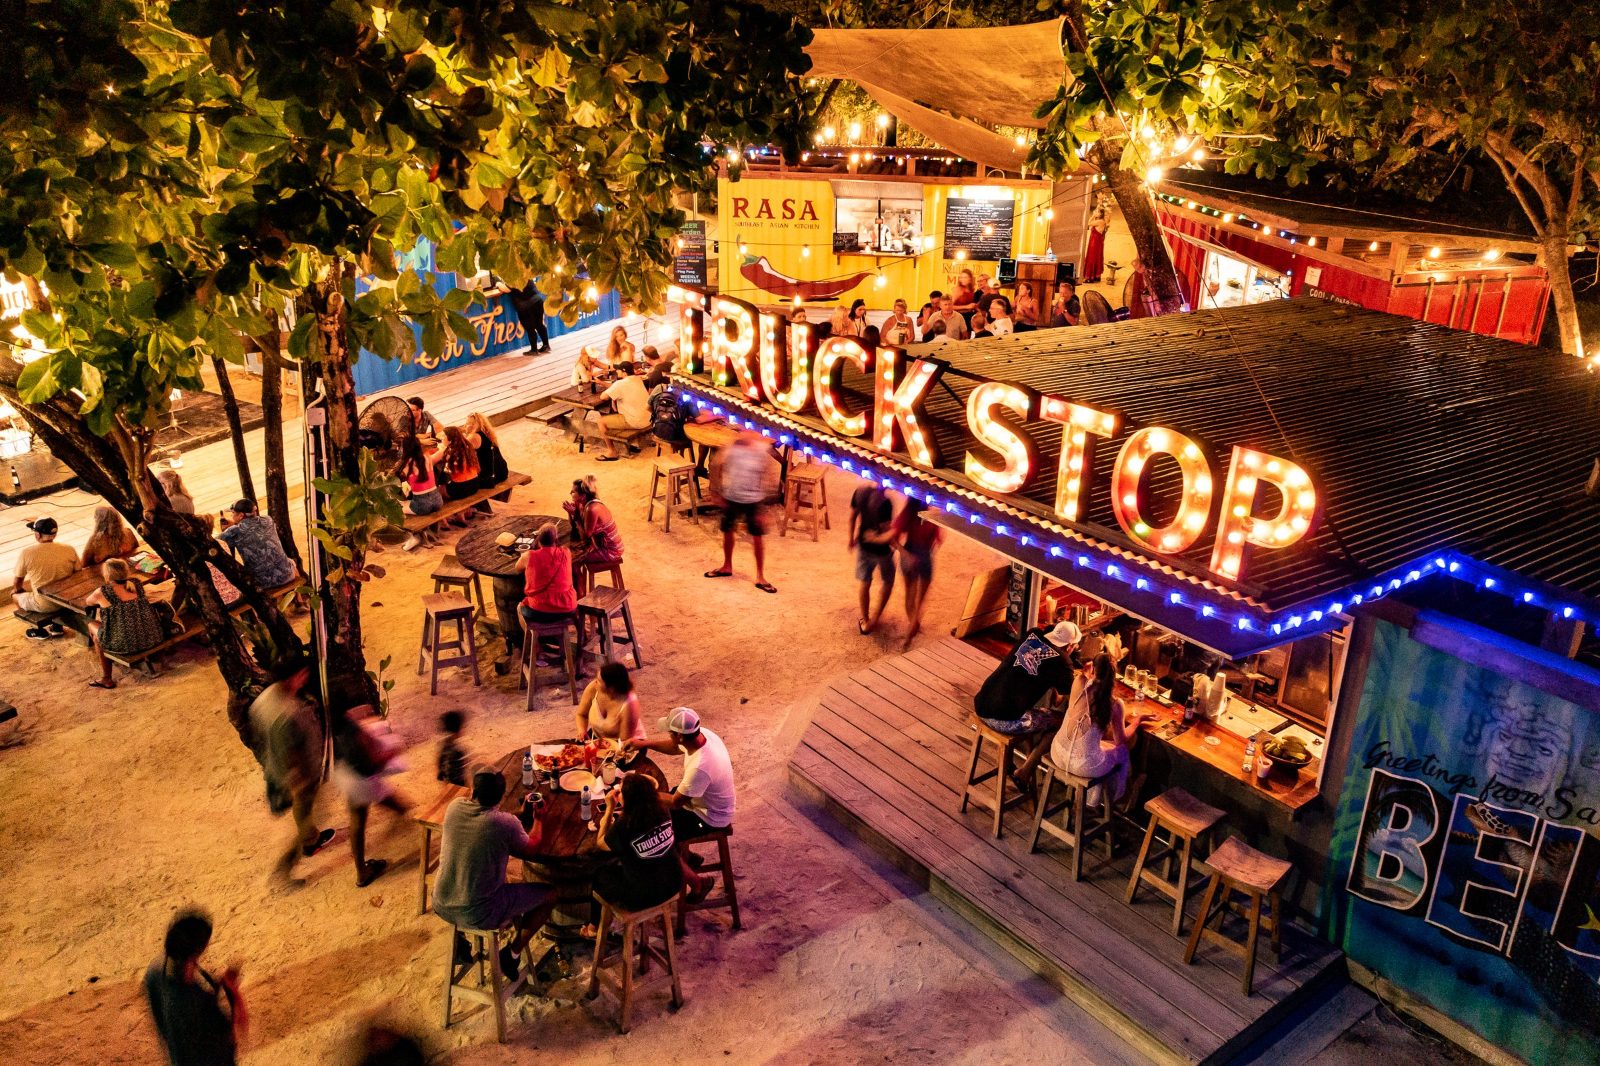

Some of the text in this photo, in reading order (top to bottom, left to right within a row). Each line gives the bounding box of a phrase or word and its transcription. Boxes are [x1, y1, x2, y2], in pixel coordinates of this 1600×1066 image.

[731, 197, 819, 221] RASA
[667, 284, 1318, 582] TRUCK STOP
[1363, 741, 1477, 794] Greetings
[1478, 774, 1545, 808] from
[636, 835, 660, 852] TRUCK
